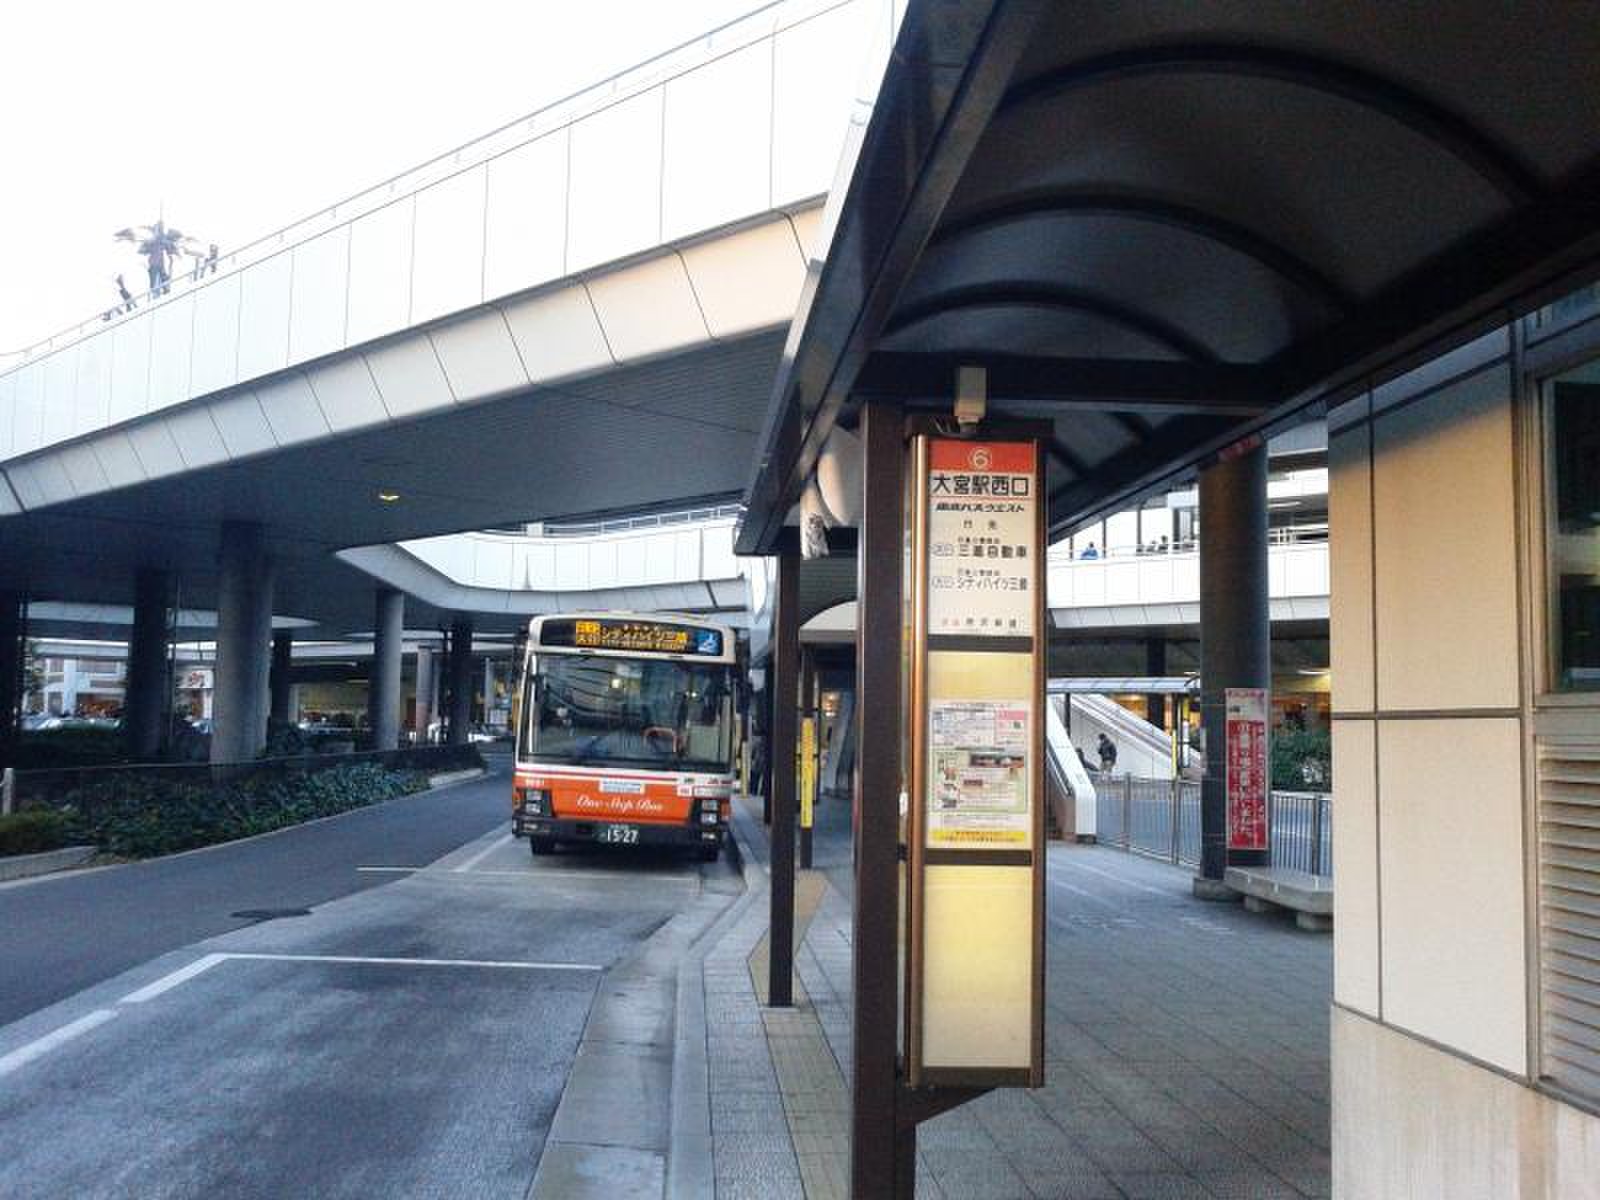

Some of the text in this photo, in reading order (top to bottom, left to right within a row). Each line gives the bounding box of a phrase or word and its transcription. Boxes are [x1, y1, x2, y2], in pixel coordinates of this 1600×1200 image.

[933, 474, 1029, 496] 大宮駅西口
